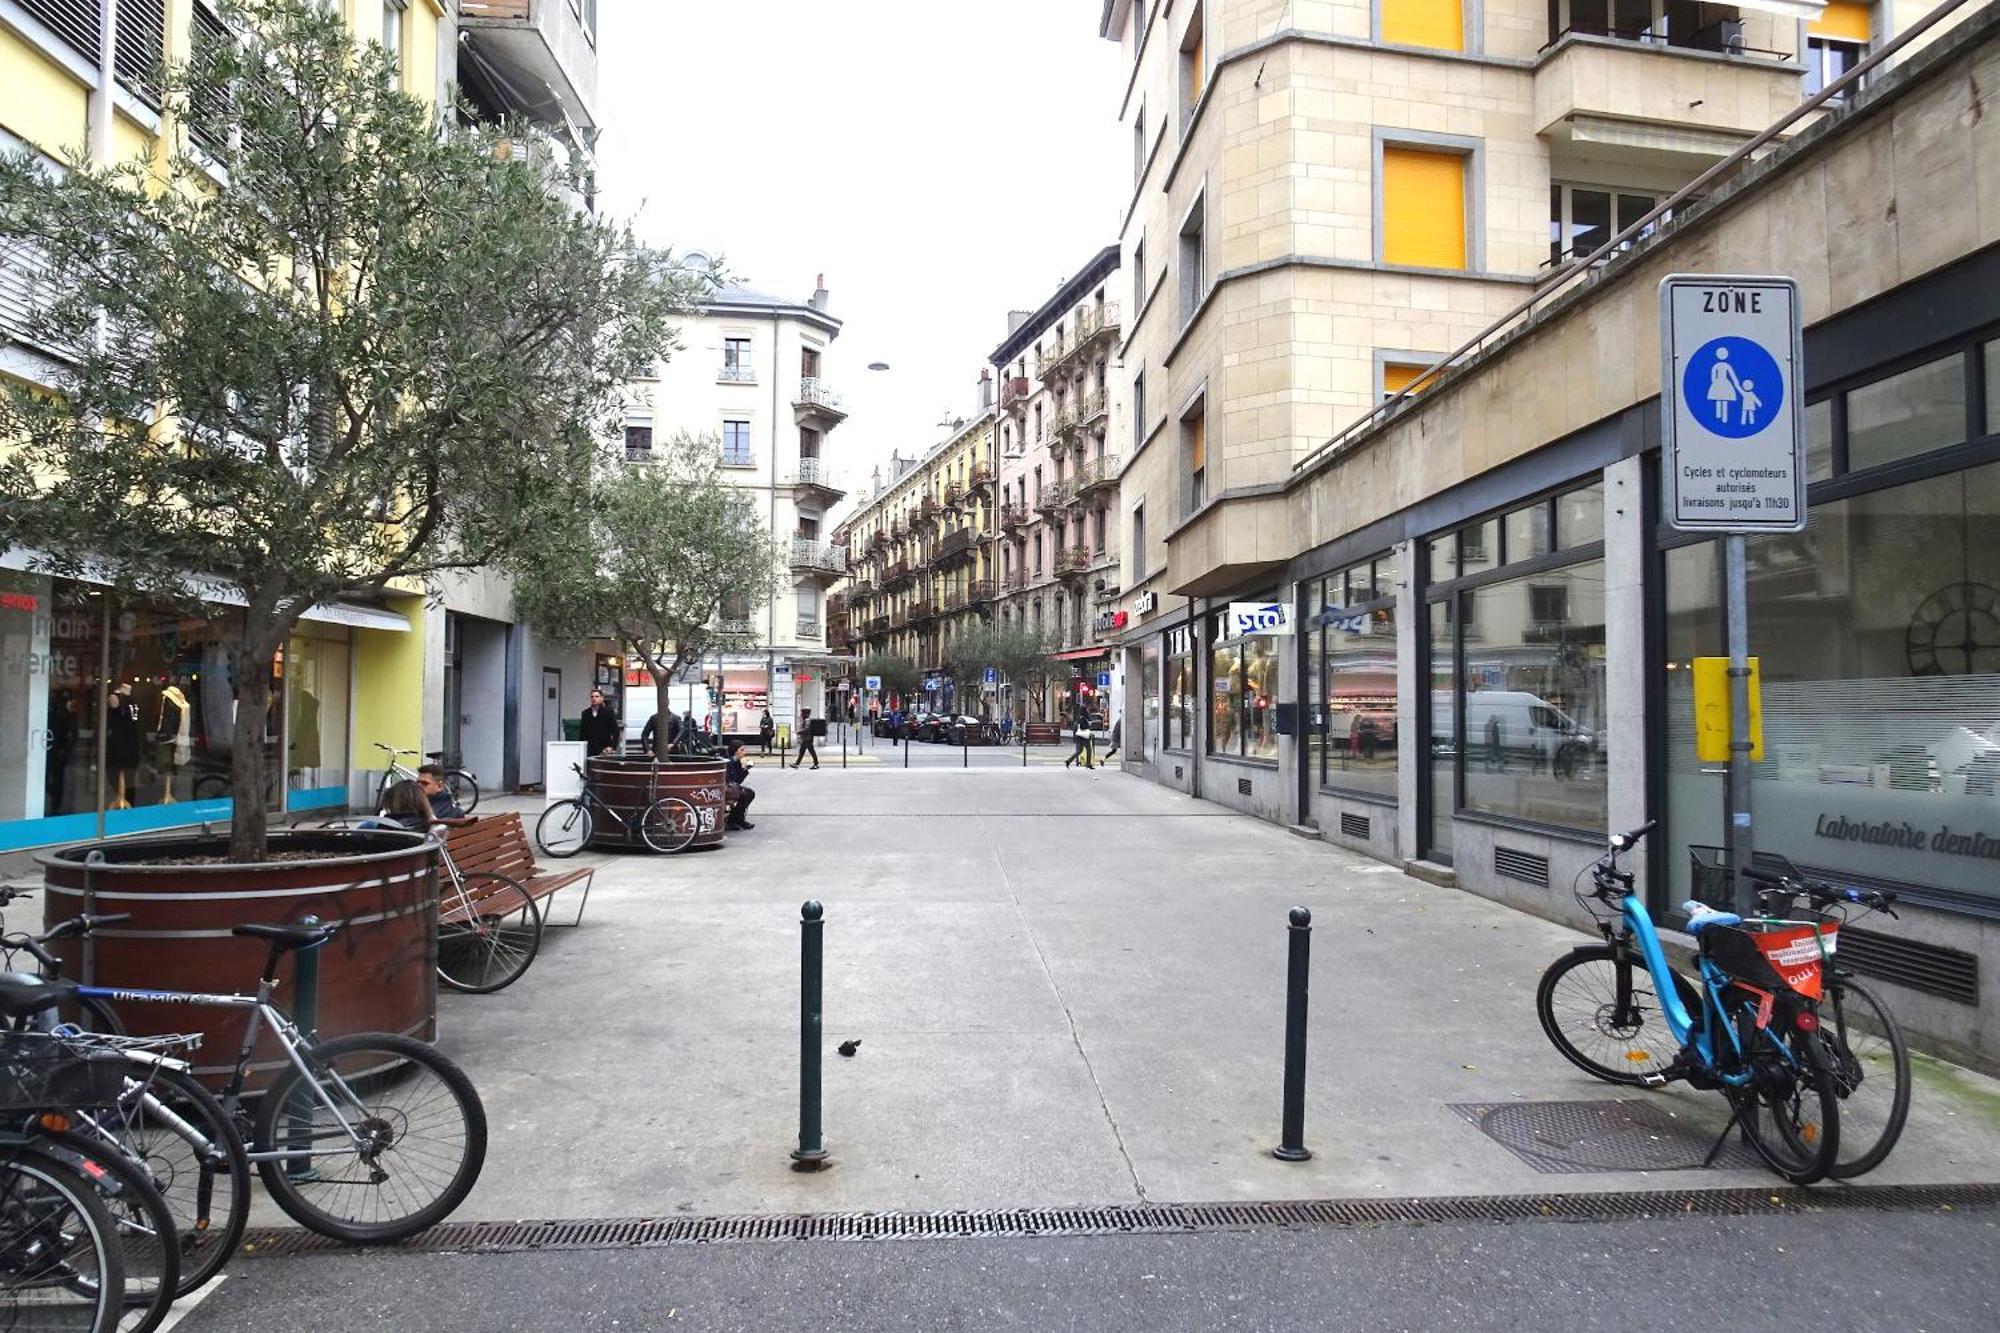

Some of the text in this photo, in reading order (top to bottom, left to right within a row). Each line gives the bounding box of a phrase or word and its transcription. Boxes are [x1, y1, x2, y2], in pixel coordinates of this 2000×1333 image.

[1703, 291, 1762, 314] ZONE
[1683, 465, 1788, 480] Cycles et cyclomoteurs
[1715, 482, 1757, 493] autorisés
[1682, 496, 1790, 511] livraisons jusqu'à 11h30
[1815, 813, 1926, 850] Laboratoire
